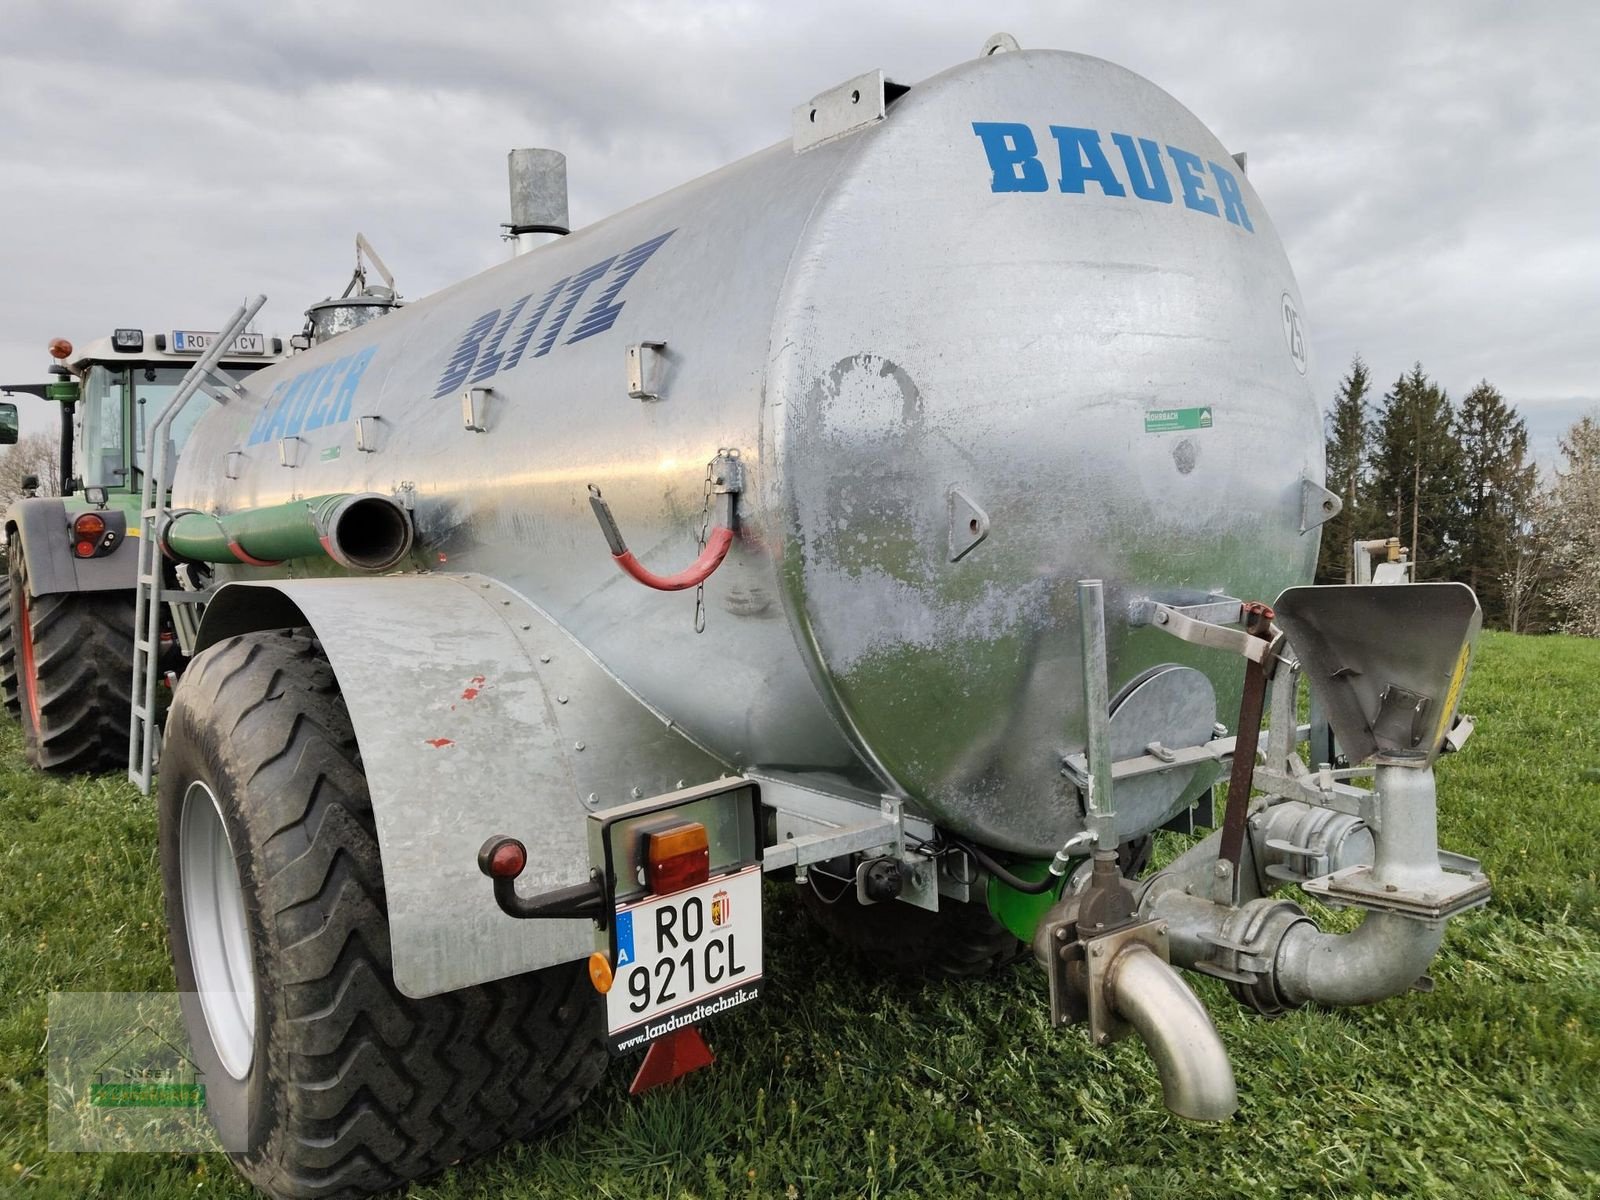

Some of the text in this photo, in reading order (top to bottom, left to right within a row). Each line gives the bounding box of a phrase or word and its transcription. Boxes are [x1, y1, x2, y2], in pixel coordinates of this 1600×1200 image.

[971, 121, 1255, 233] BAUER
[187, 335, 205, 348] RO
[429, 228, 679, 400] BLITZ
[1284, 304, 1304, 362] 25
[247, 344, 380, 448] BAUER
[655, 896, 704, 953] RO
[617, 948, 629, 965] A
[628, 933, 746, 1013] 921CL
[617, 988, 759, 1051] www.landundtechnik.at
